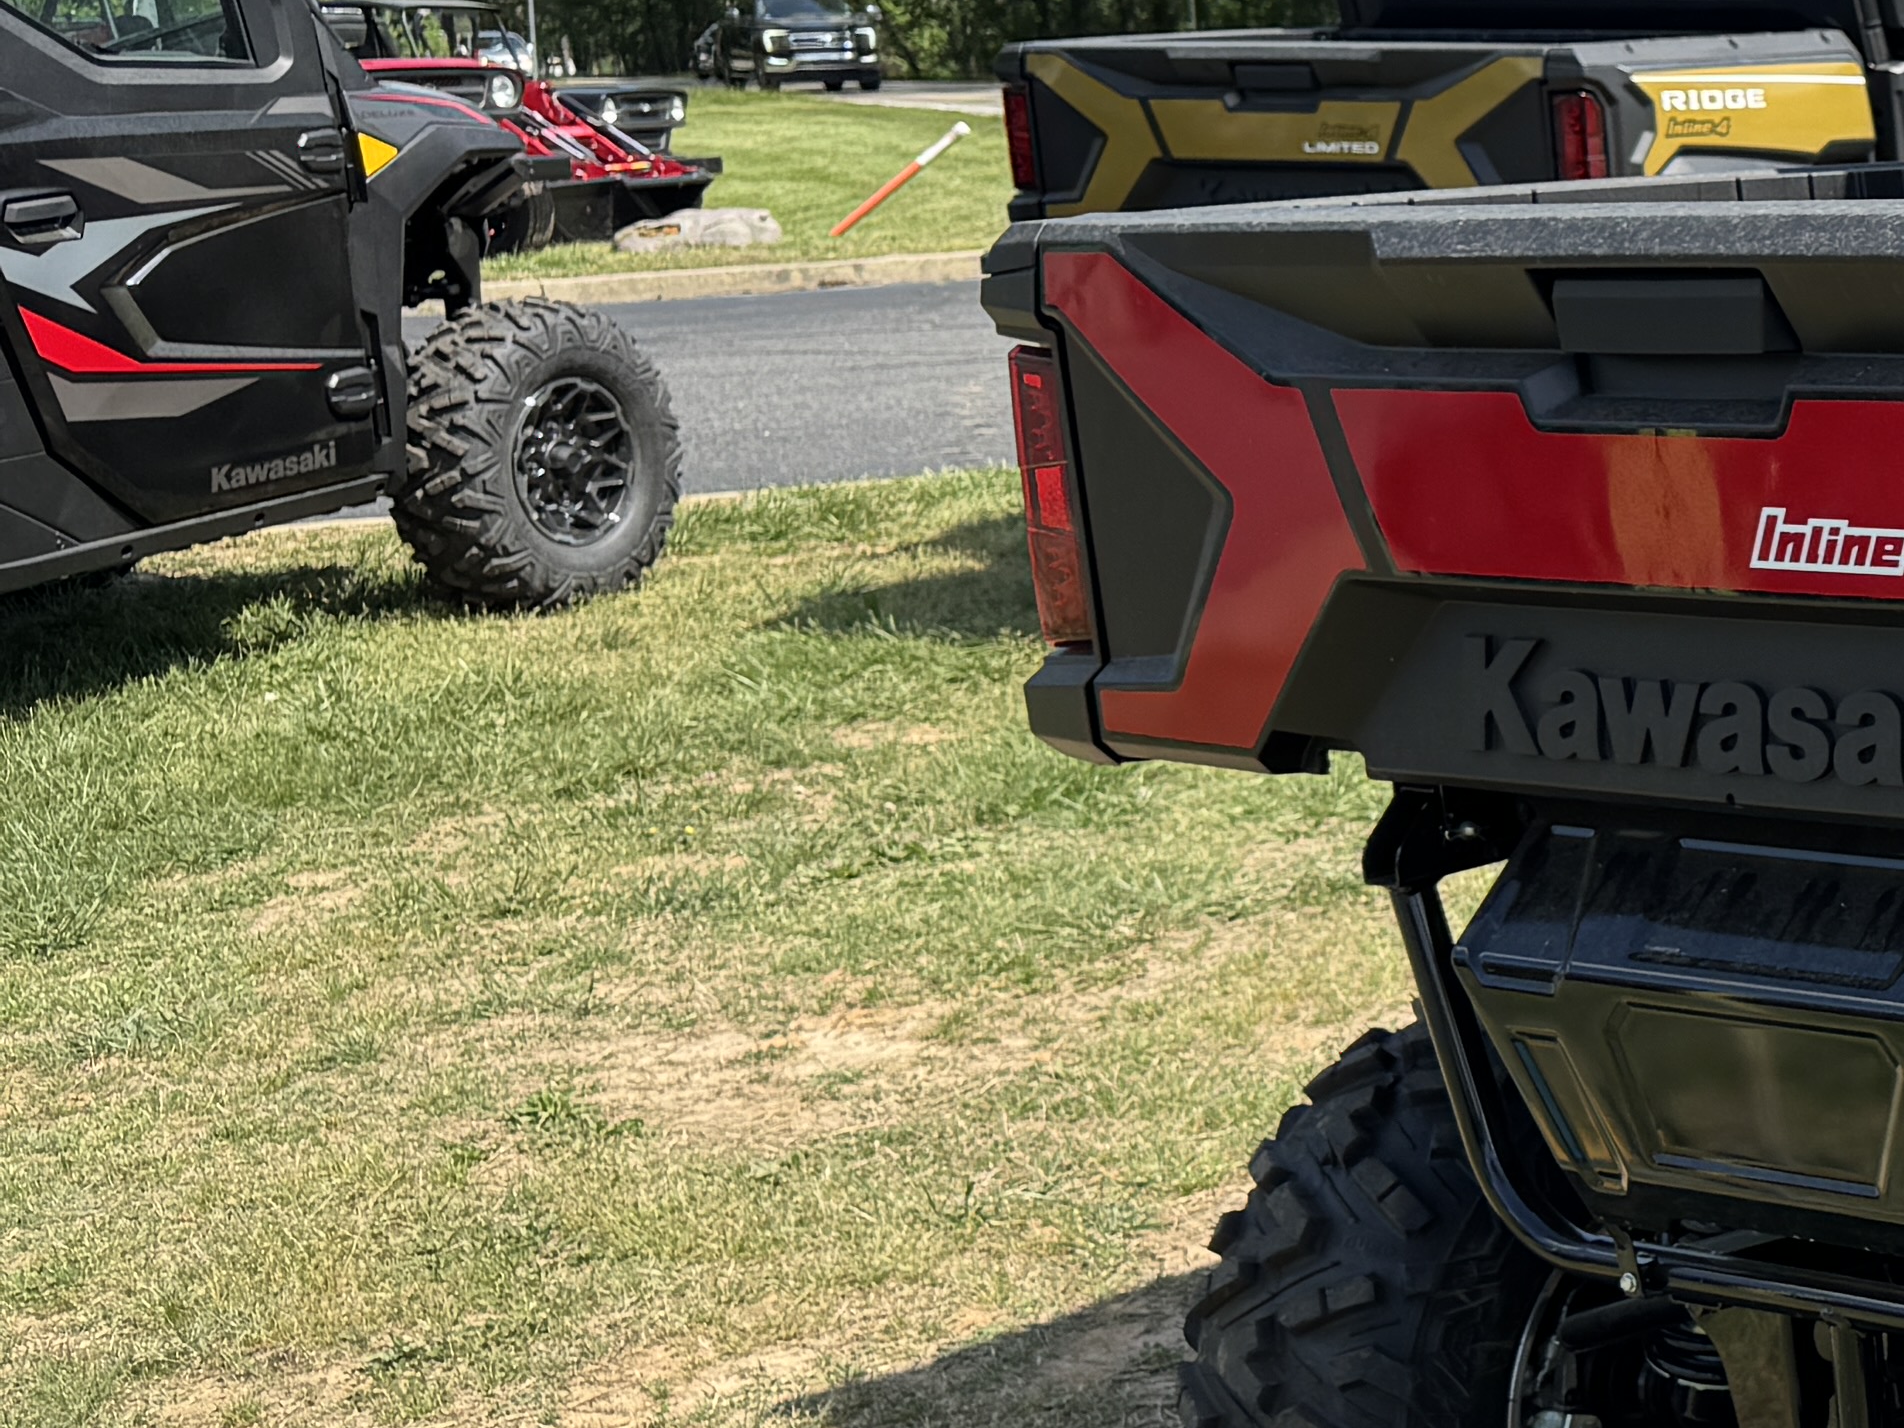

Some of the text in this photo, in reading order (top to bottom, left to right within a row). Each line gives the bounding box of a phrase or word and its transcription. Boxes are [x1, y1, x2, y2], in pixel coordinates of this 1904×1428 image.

[1660, 88, 1768, 112] RIDGE
[1302, 140, 1380, 155] LIMITED
[211, 439, 337, 494] Kawasaki
